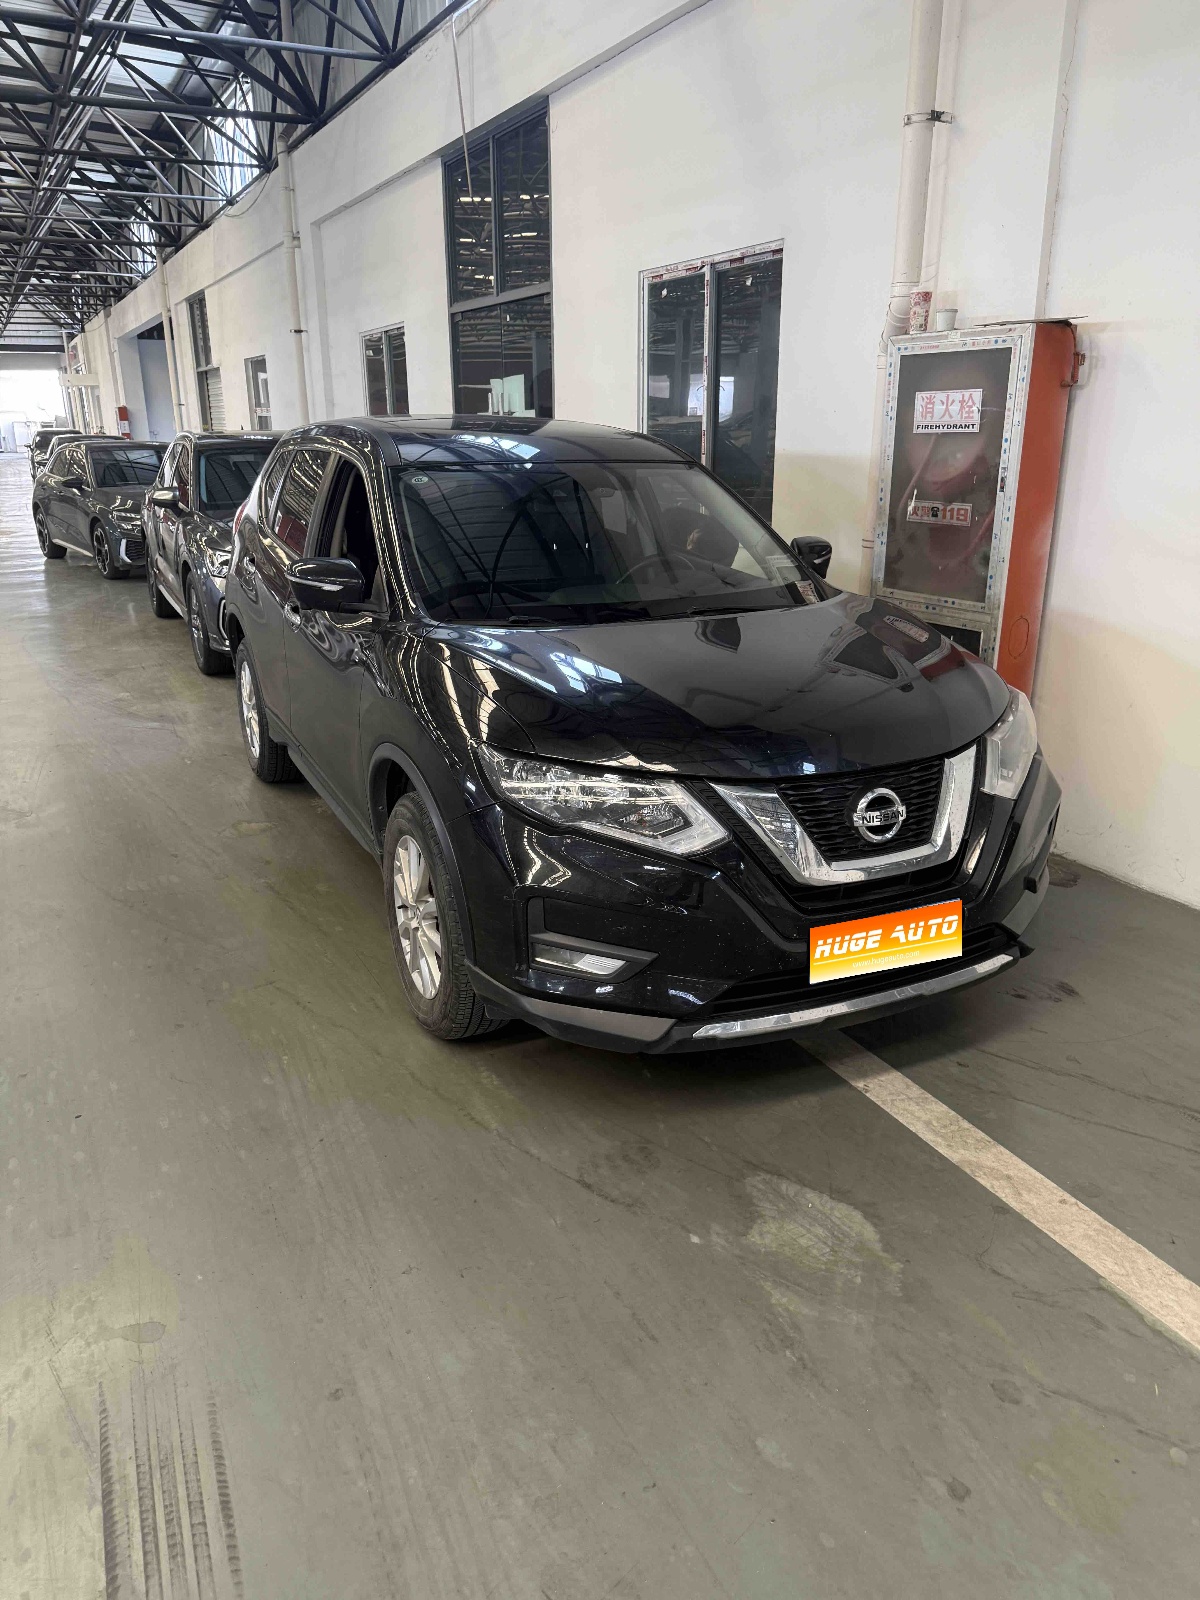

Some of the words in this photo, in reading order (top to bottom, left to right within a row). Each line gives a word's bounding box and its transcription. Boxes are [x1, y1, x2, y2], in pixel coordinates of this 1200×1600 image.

[920, 393, 977, 420] 消火栓
[941, 506, 969, 522] 119
[861, 809, 904, 824] NISSAN
